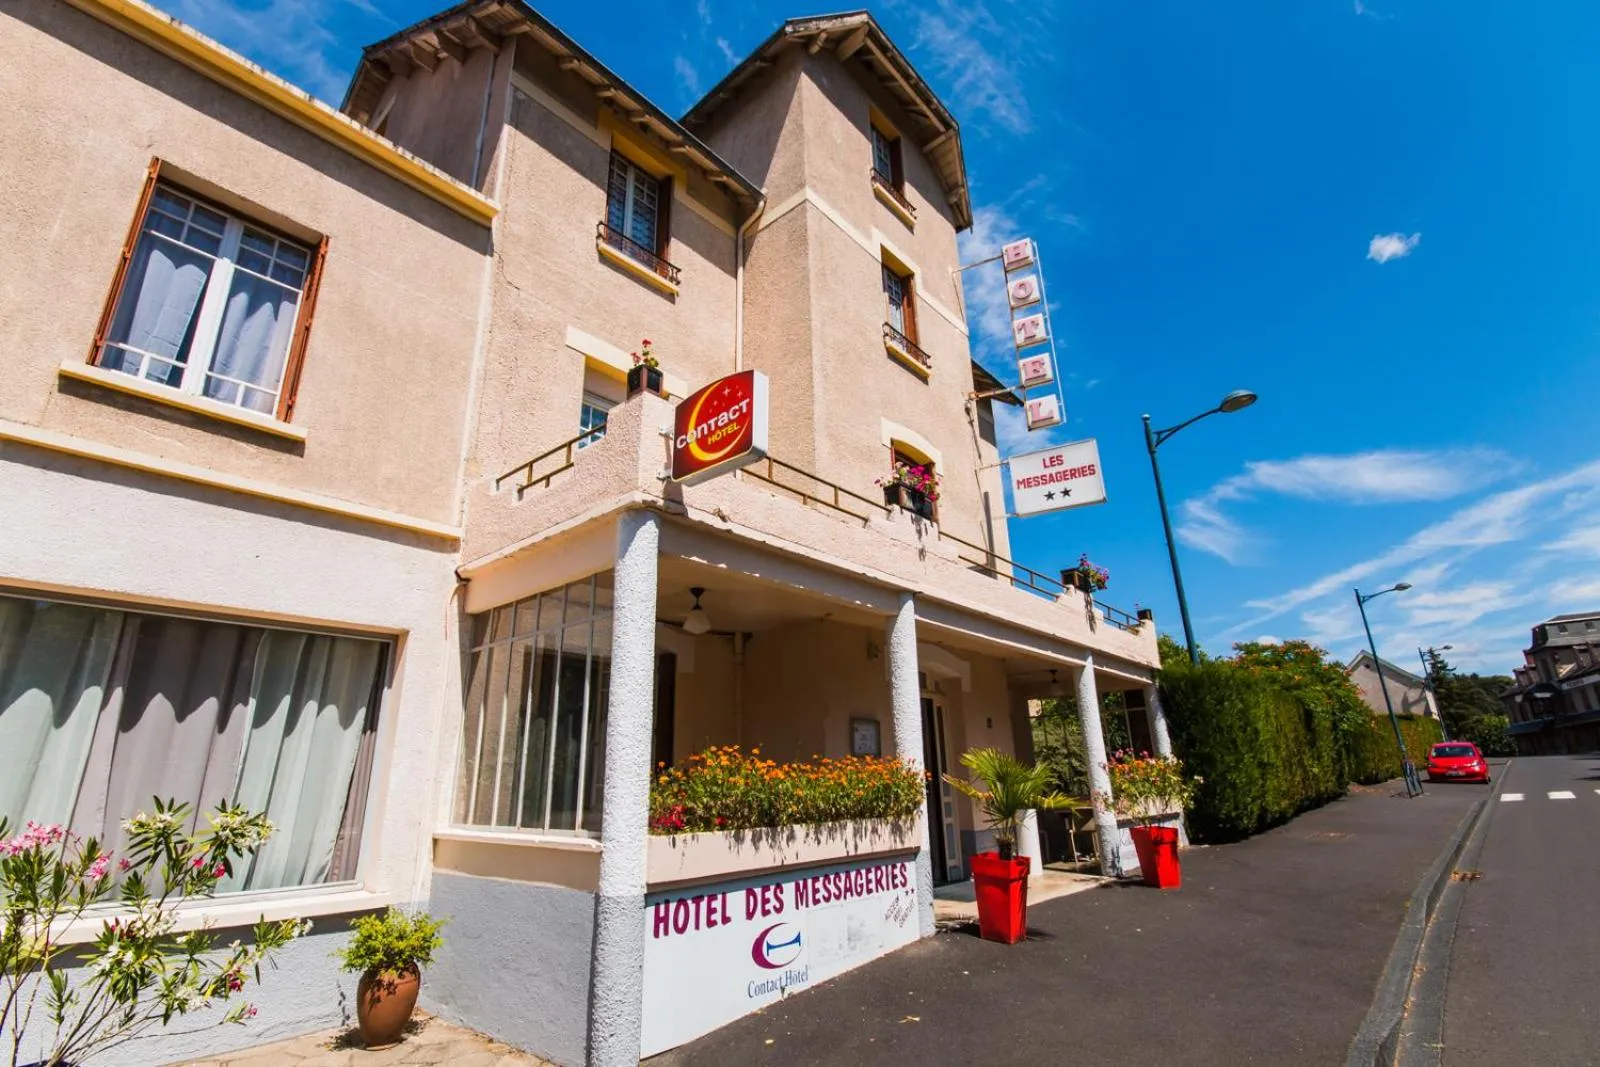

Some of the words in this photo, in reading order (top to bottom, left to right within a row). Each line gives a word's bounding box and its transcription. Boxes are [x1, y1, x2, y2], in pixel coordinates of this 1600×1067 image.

[1004, 242, 1055, 423] HOTEL
[1042, 454, 1065, 469] LES
[1016, 464, 1097, 490] MESSAGERIES
[653, 892, 732, 939] HOTEL
[745, 882, 785, 921] DES
[794, 863, 908, 910] MESSAGERIES
[747, 976, 783, 999] Contact
